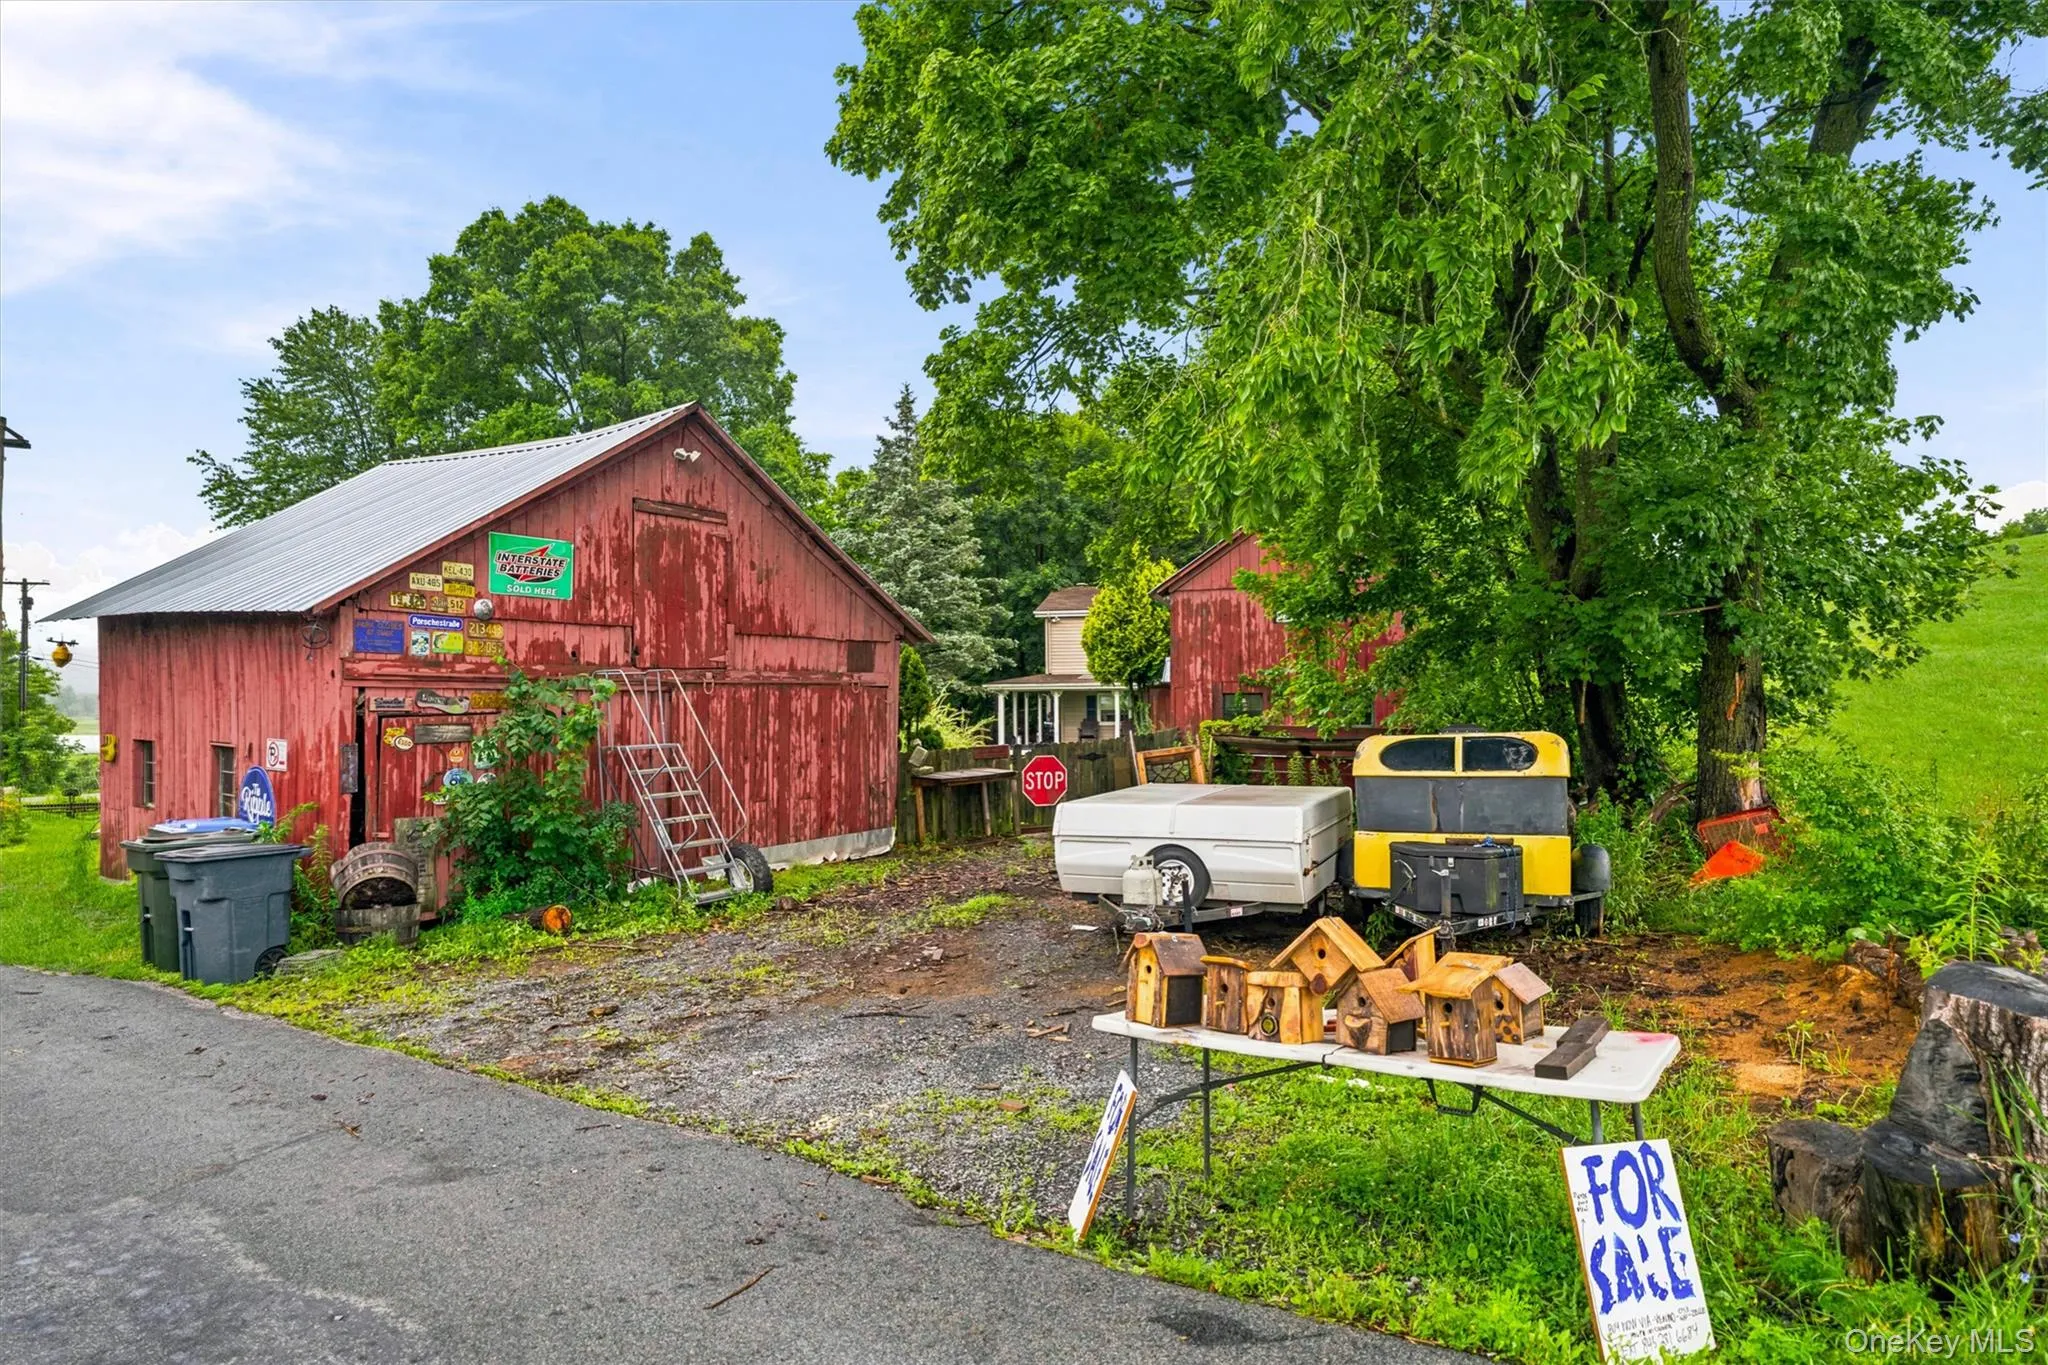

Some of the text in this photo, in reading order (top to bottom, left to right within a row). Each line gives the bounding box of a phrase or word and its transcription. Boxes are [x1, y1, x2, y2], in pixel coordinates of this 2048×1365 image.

[497, 553, 566, 568] INTERSTATE
[500, 563, 560, 577] BATTERIES
[506, 584, 557, 596] SOLD HERE
[1025, 771, 1064, 790] STOP
[1581, 1141, 1682, 1230] FOR
[1590, 1226, 1697, 1315] SALE
